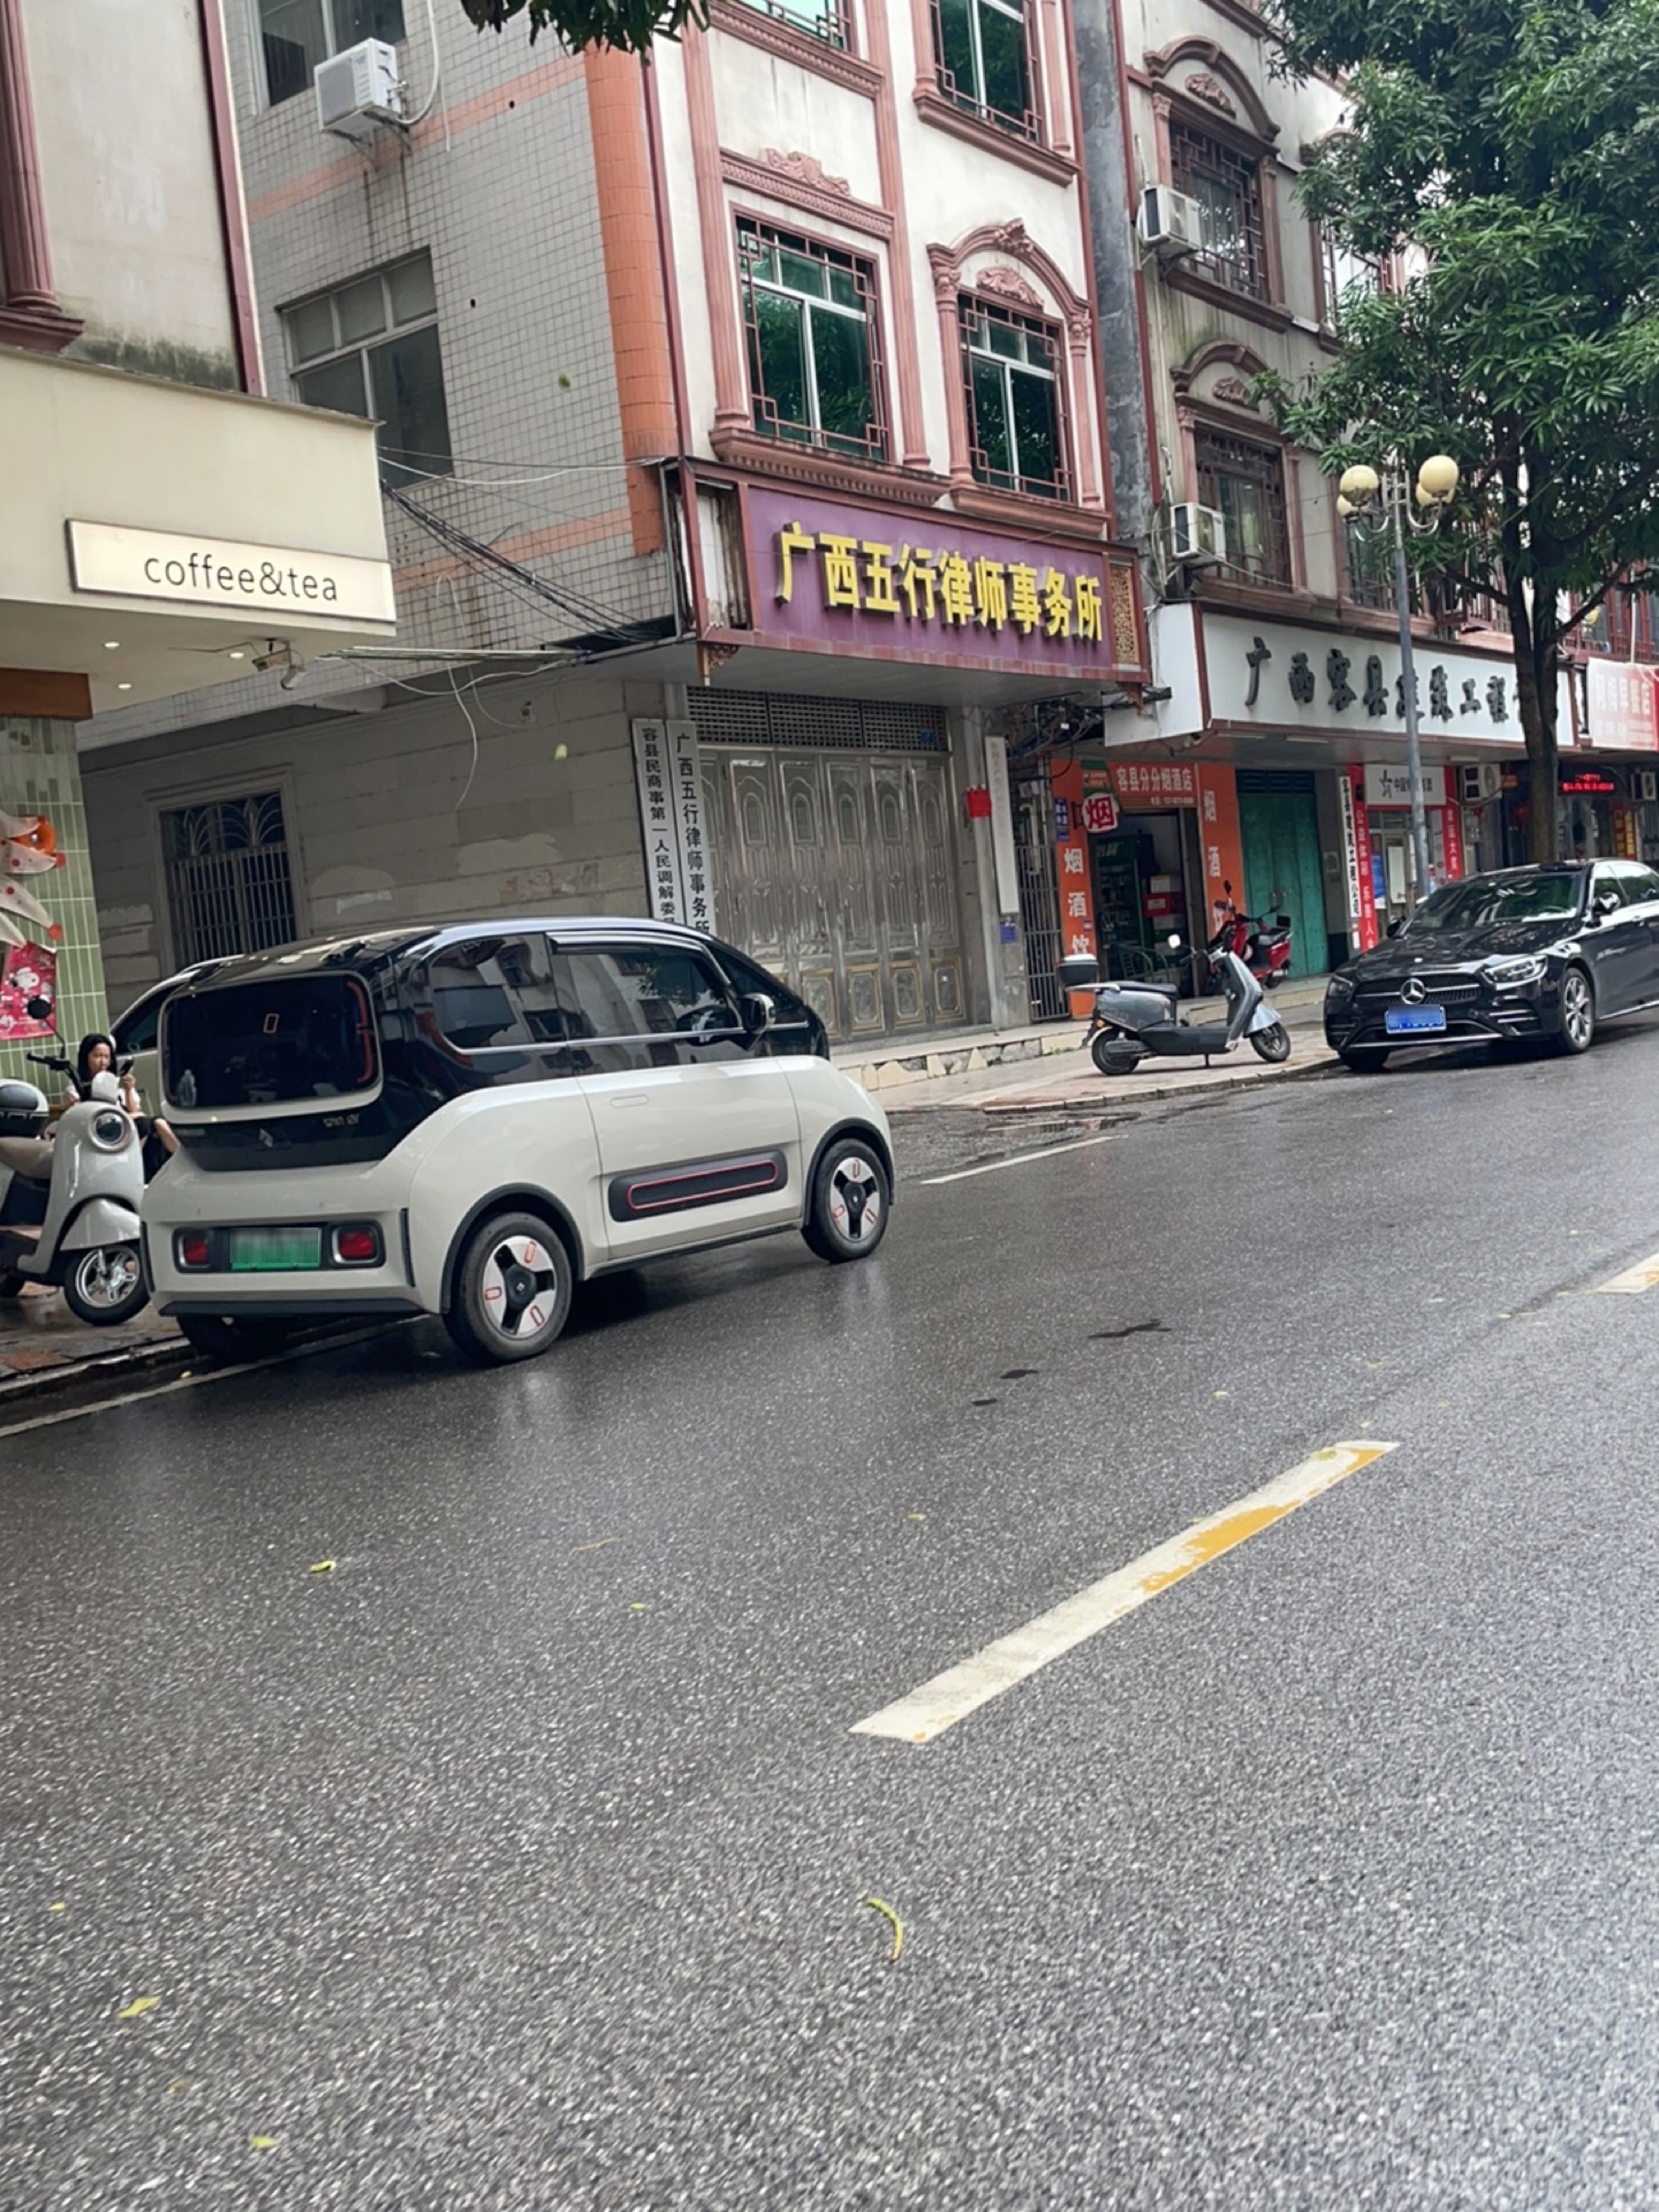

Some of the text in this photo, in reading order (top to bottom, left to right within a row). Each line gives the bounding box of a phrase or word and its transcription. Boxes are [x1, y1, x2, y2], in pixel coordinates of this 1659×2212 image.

[143, 552, 338, 602] coffee&tea
[774, 520, 1103, 641] 广西五行律师事务所
[1084, 796, 1116, 831] 烟
